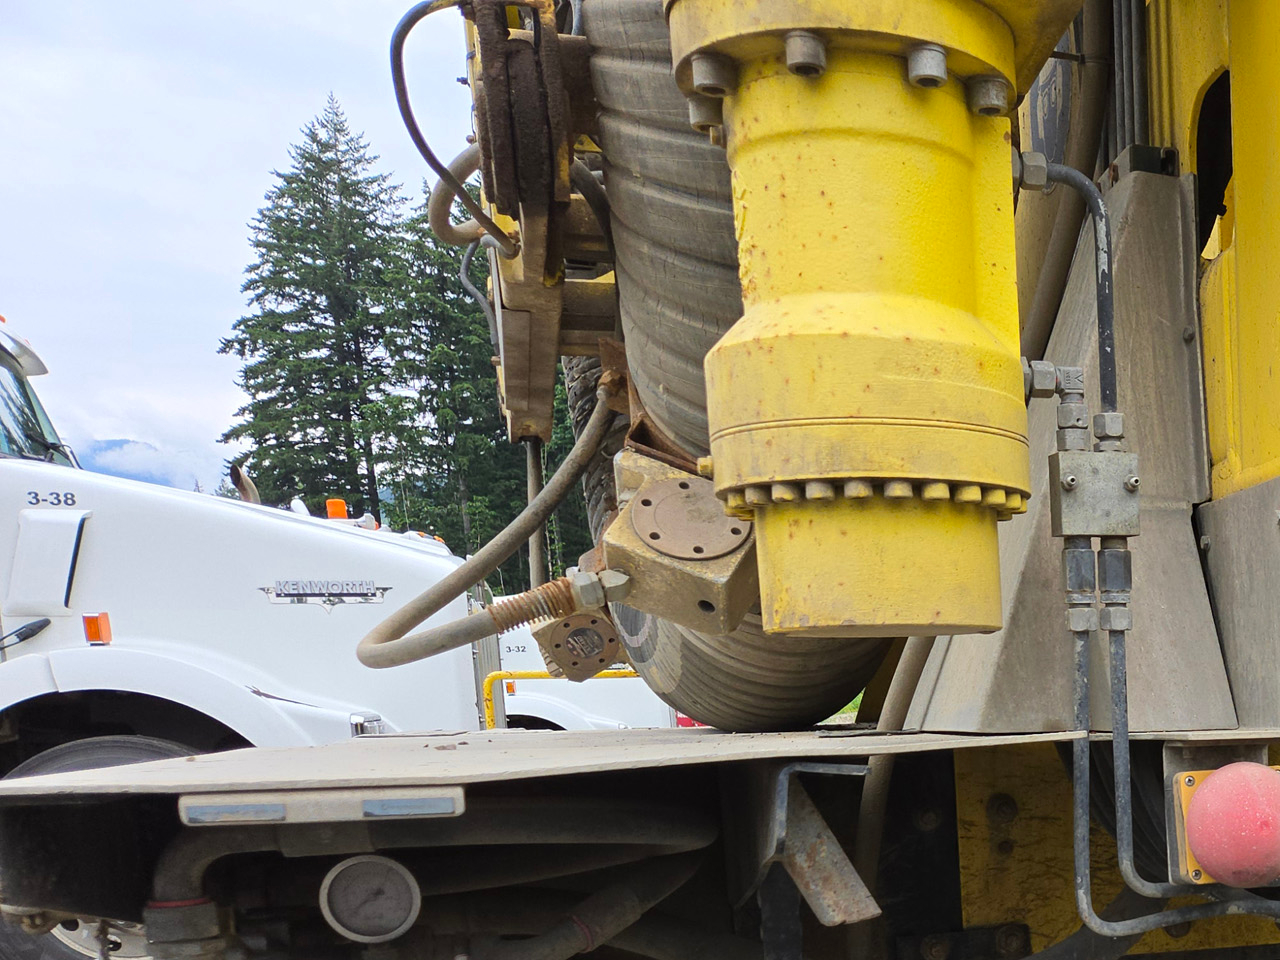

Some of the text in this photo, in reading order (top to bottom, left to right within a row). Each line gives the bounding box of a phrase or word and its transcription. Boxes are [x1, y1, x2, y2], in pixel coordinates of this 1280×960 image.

[27, 491, 77, 506] 3-38
[275, 580, 375, 594] KENWORTH
[505, 645, 527, 653] 3-32
